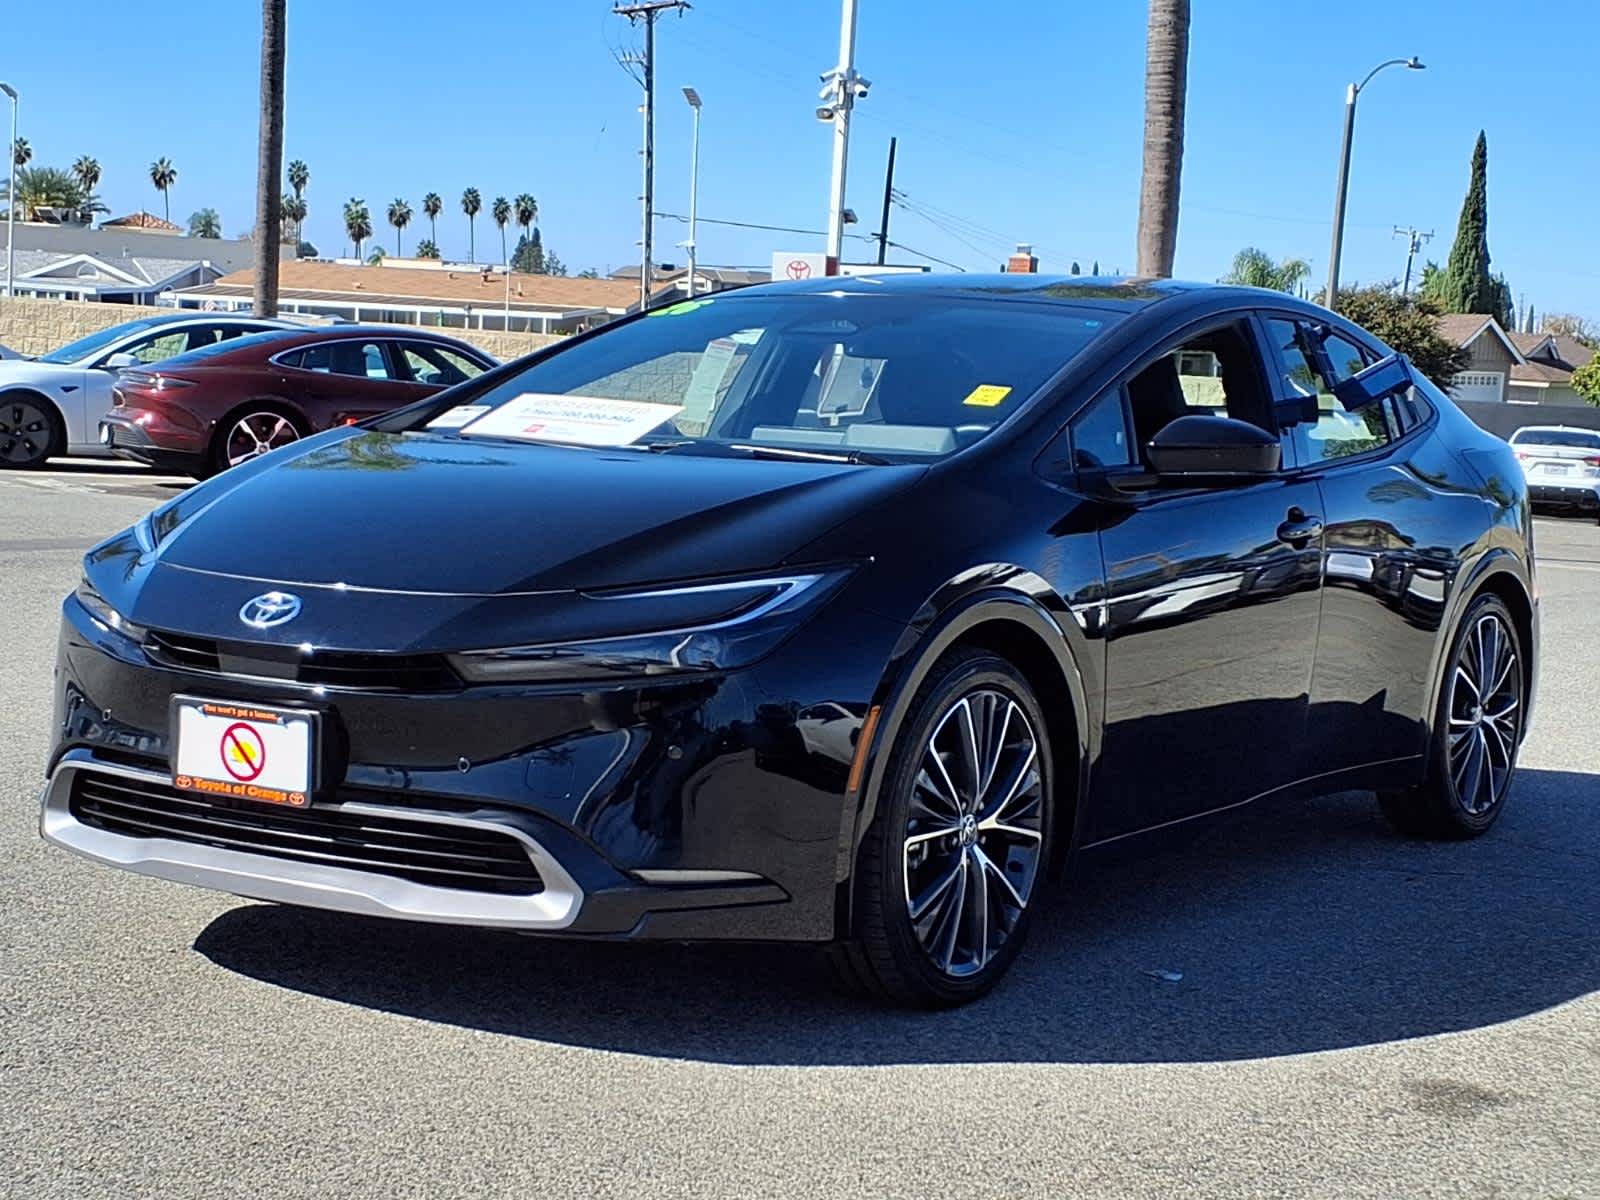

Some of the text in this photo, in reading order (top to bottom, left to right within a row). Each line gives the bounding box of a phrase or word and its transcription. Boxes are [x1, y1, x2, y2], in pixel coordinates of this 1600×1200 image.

[193, 776, 287, 801] Toyota of Orange
